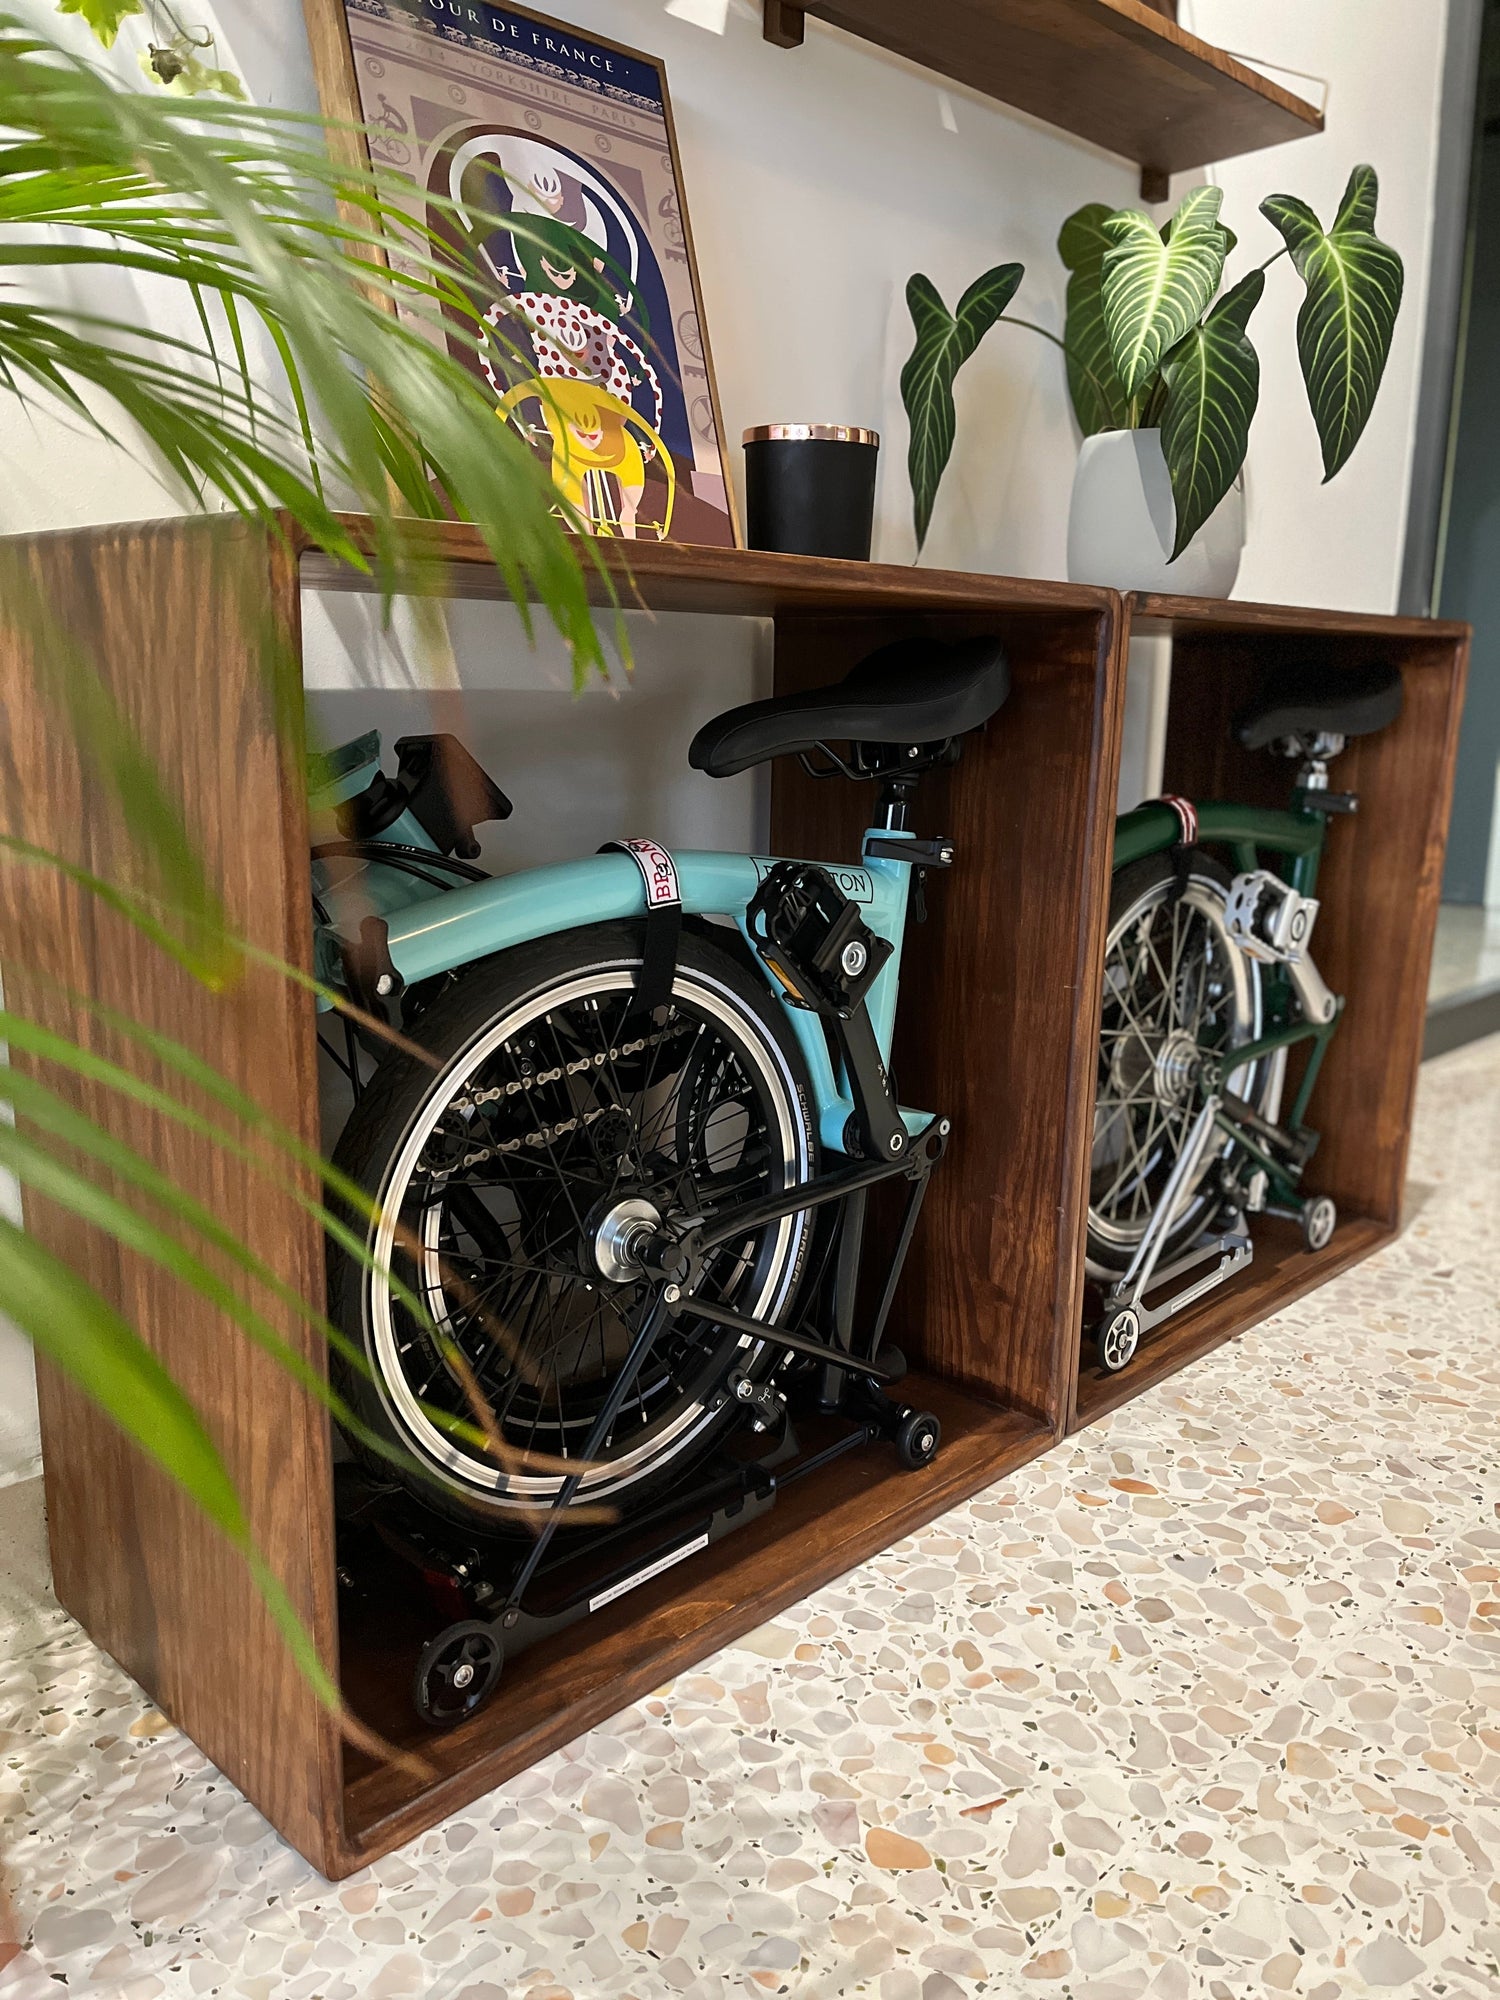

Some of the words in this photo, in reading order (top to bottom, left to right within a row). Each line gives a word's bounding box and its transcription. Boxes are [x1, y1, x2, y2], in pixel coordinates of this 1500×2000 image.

[419, 0, 480, 24] OUR
[491, 18, 520, 38] DE
[532, 32, 615, 73] FRANCE
[470, 61, 571, 106] YORKSHIRE
[591, 104, 638, 128] PARIS
[795, 1082, 816, 1163] SCHWALBE
